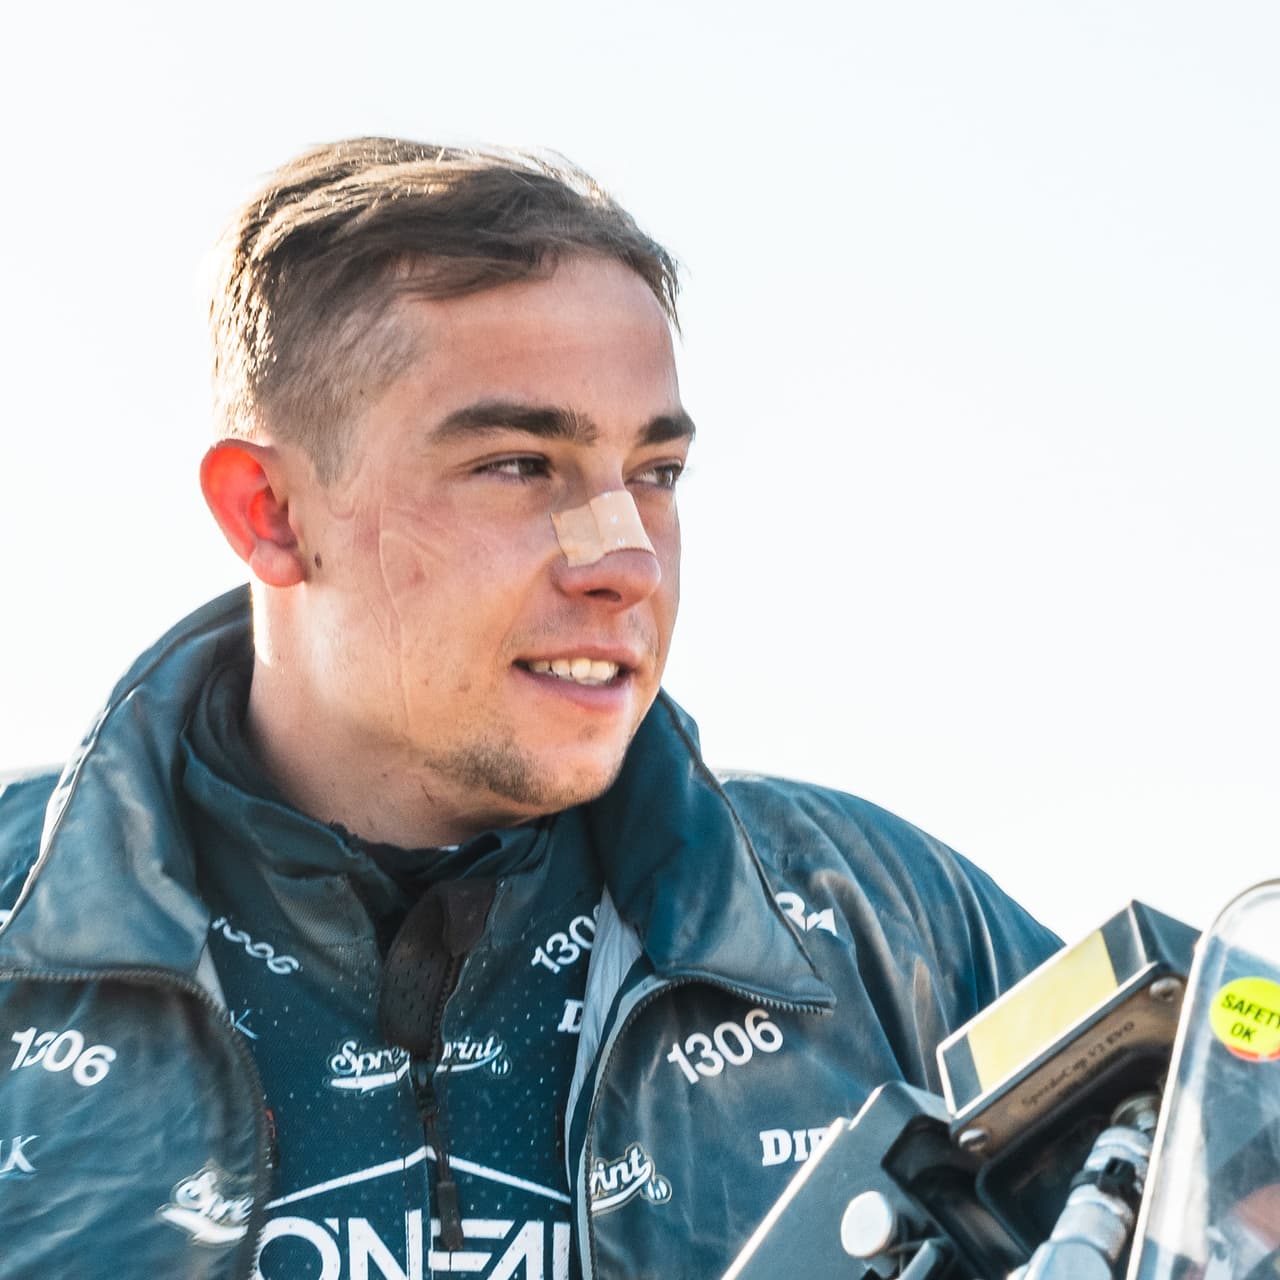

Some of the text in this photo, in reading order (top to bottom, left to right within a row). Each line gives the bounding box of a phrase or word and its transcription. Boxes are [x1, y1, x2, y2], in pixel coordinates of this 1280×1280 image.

[667, 1008, 784, 1085] 1306
[1230, 1021, 1257, 1043] OK
[590, 1147, 646, 1195] rint
